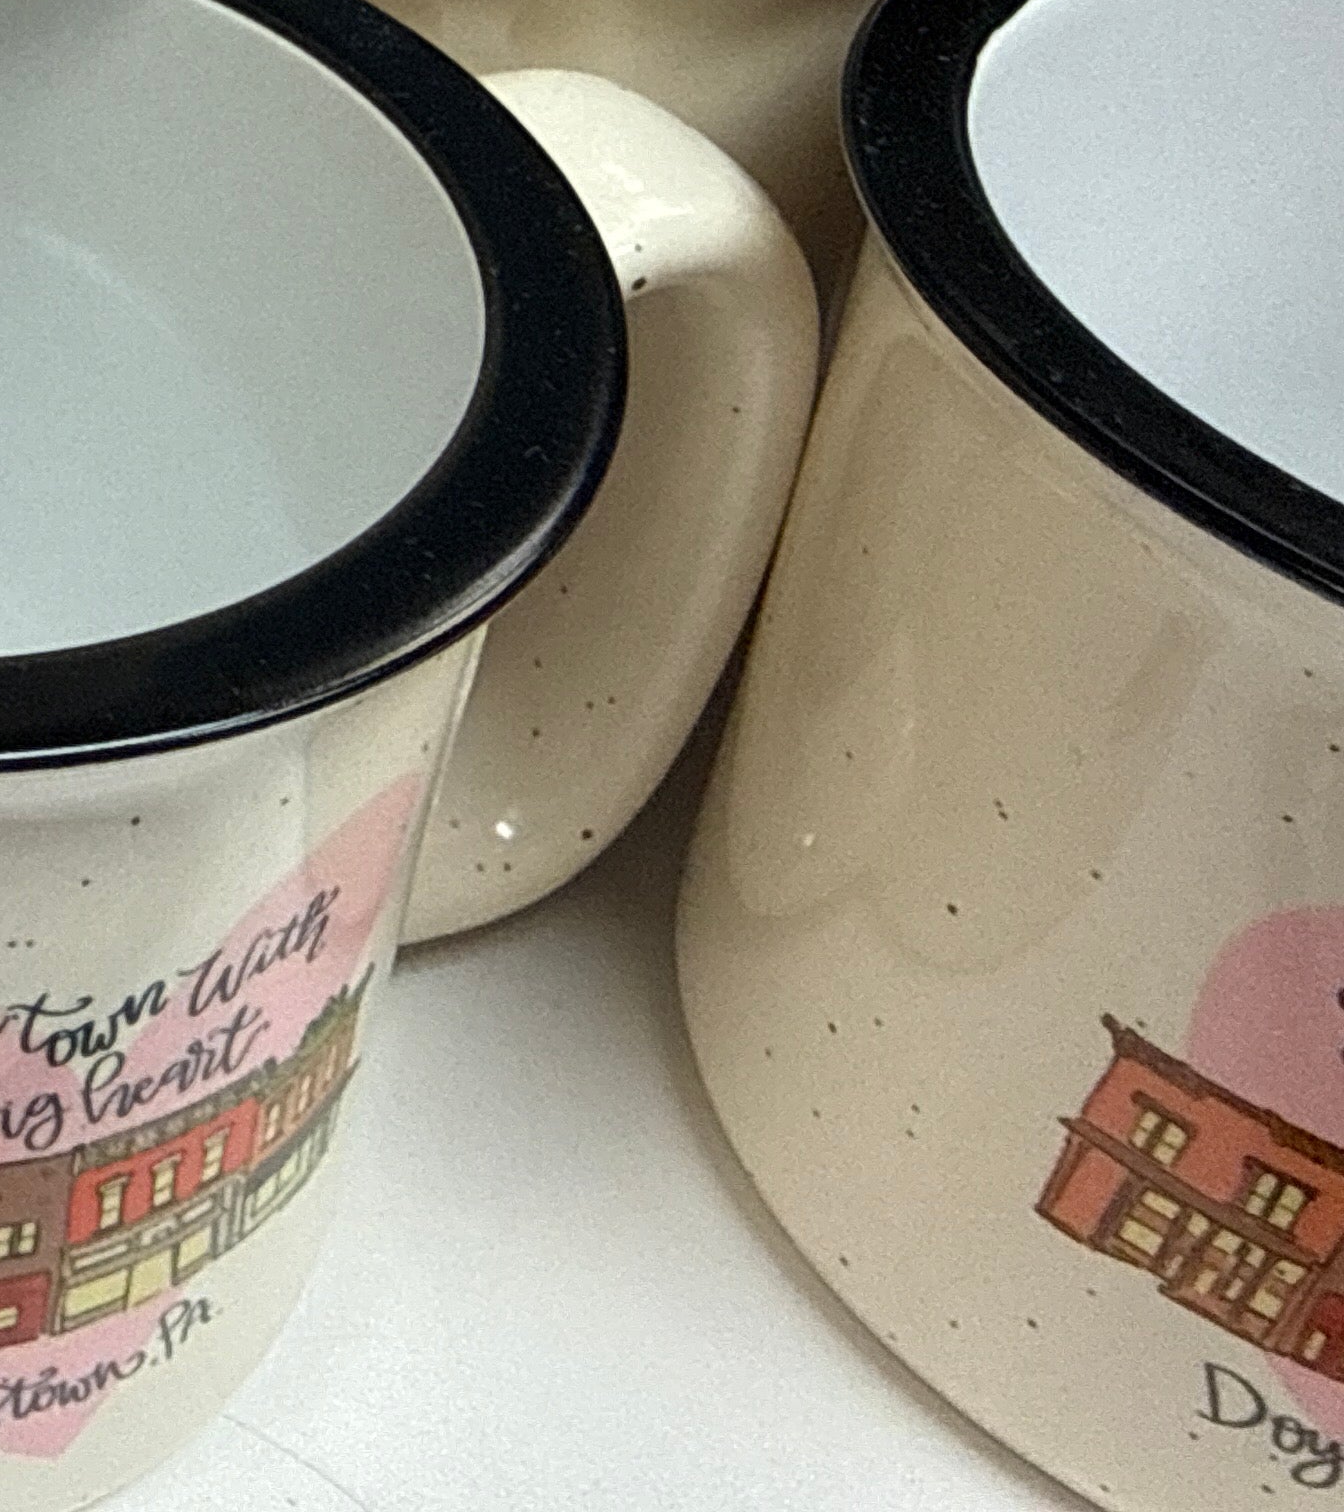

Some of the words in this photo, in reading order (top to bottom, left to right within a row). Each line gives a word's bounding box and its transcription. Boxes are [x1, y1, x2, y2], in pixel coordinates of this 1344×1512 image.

[6, 980, 169, 1068] town
[177, 886, 342, 1017] With
[82, 1005, 271, 1125] heart
